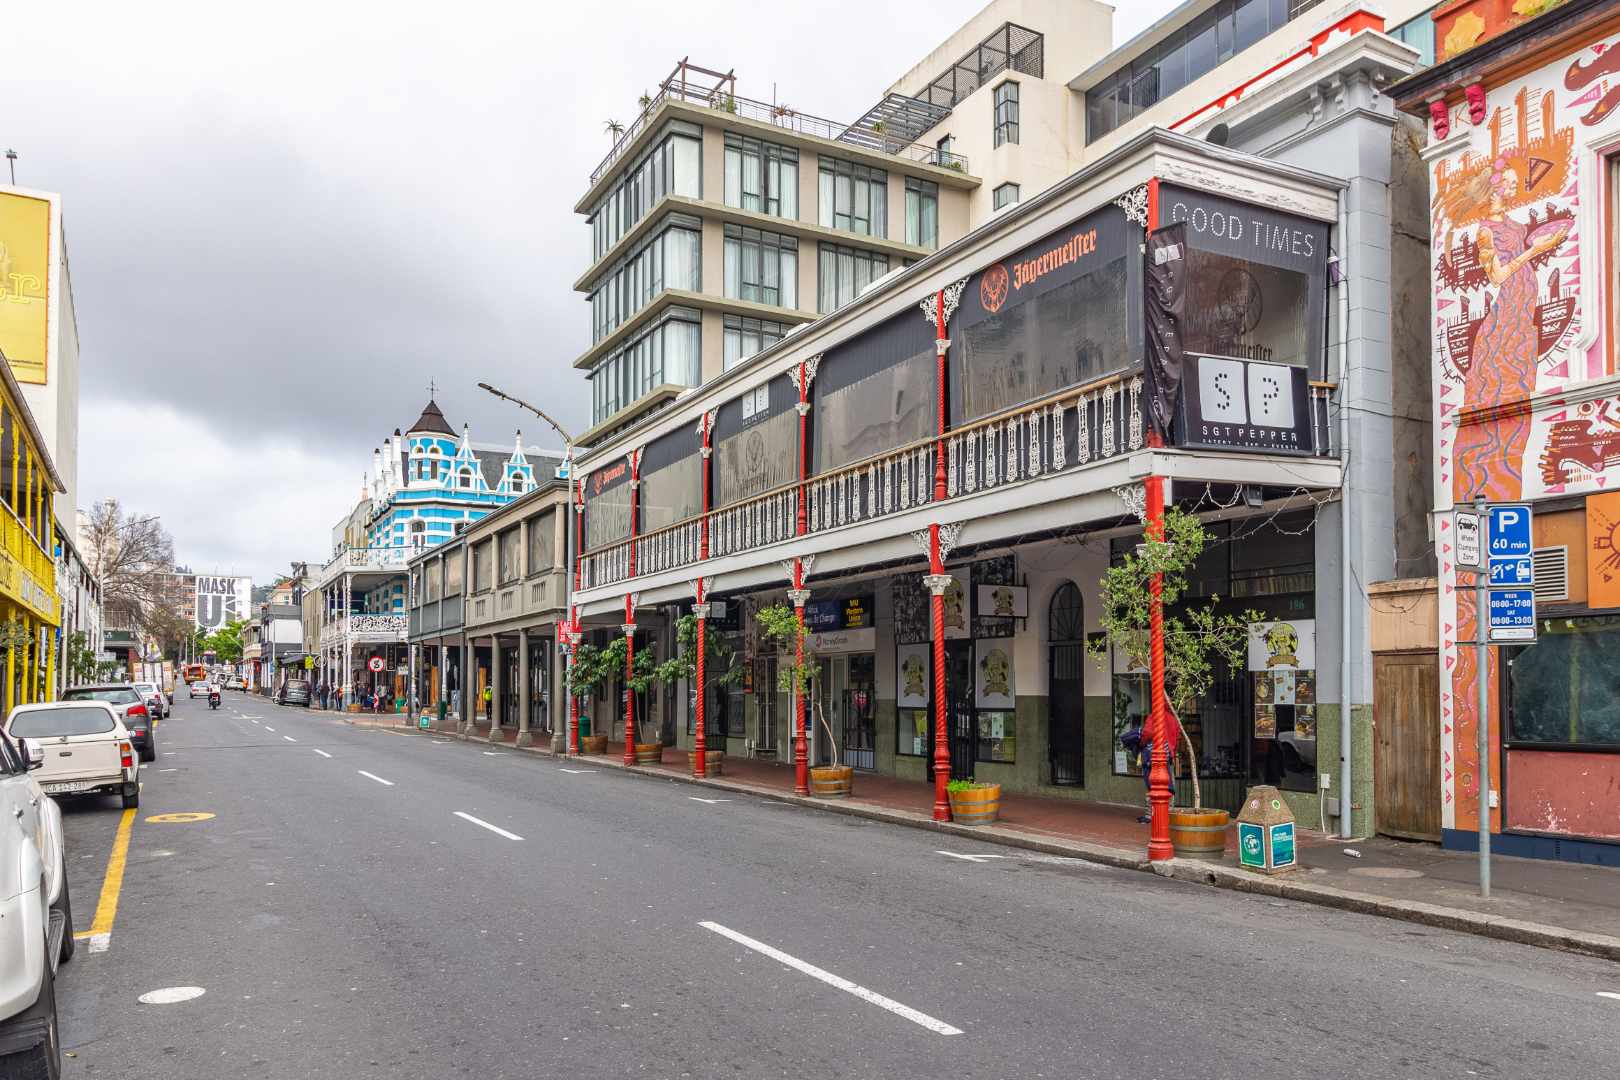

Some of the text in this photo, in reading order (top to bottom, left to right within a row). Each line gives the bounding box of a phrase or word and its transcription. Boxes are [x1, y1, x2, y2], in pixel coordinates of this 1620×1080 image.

[1172, 202, 1313, 257] GOOD TIMES
[1214, 372, 1279, 414] S P
[1202, 425, 1297, 442] SGT PEPPER
[1499, 511, 1519, 533] P
[1492, 538, 1527, 549] 60 min
[198, 577, 236, 595] MASK
